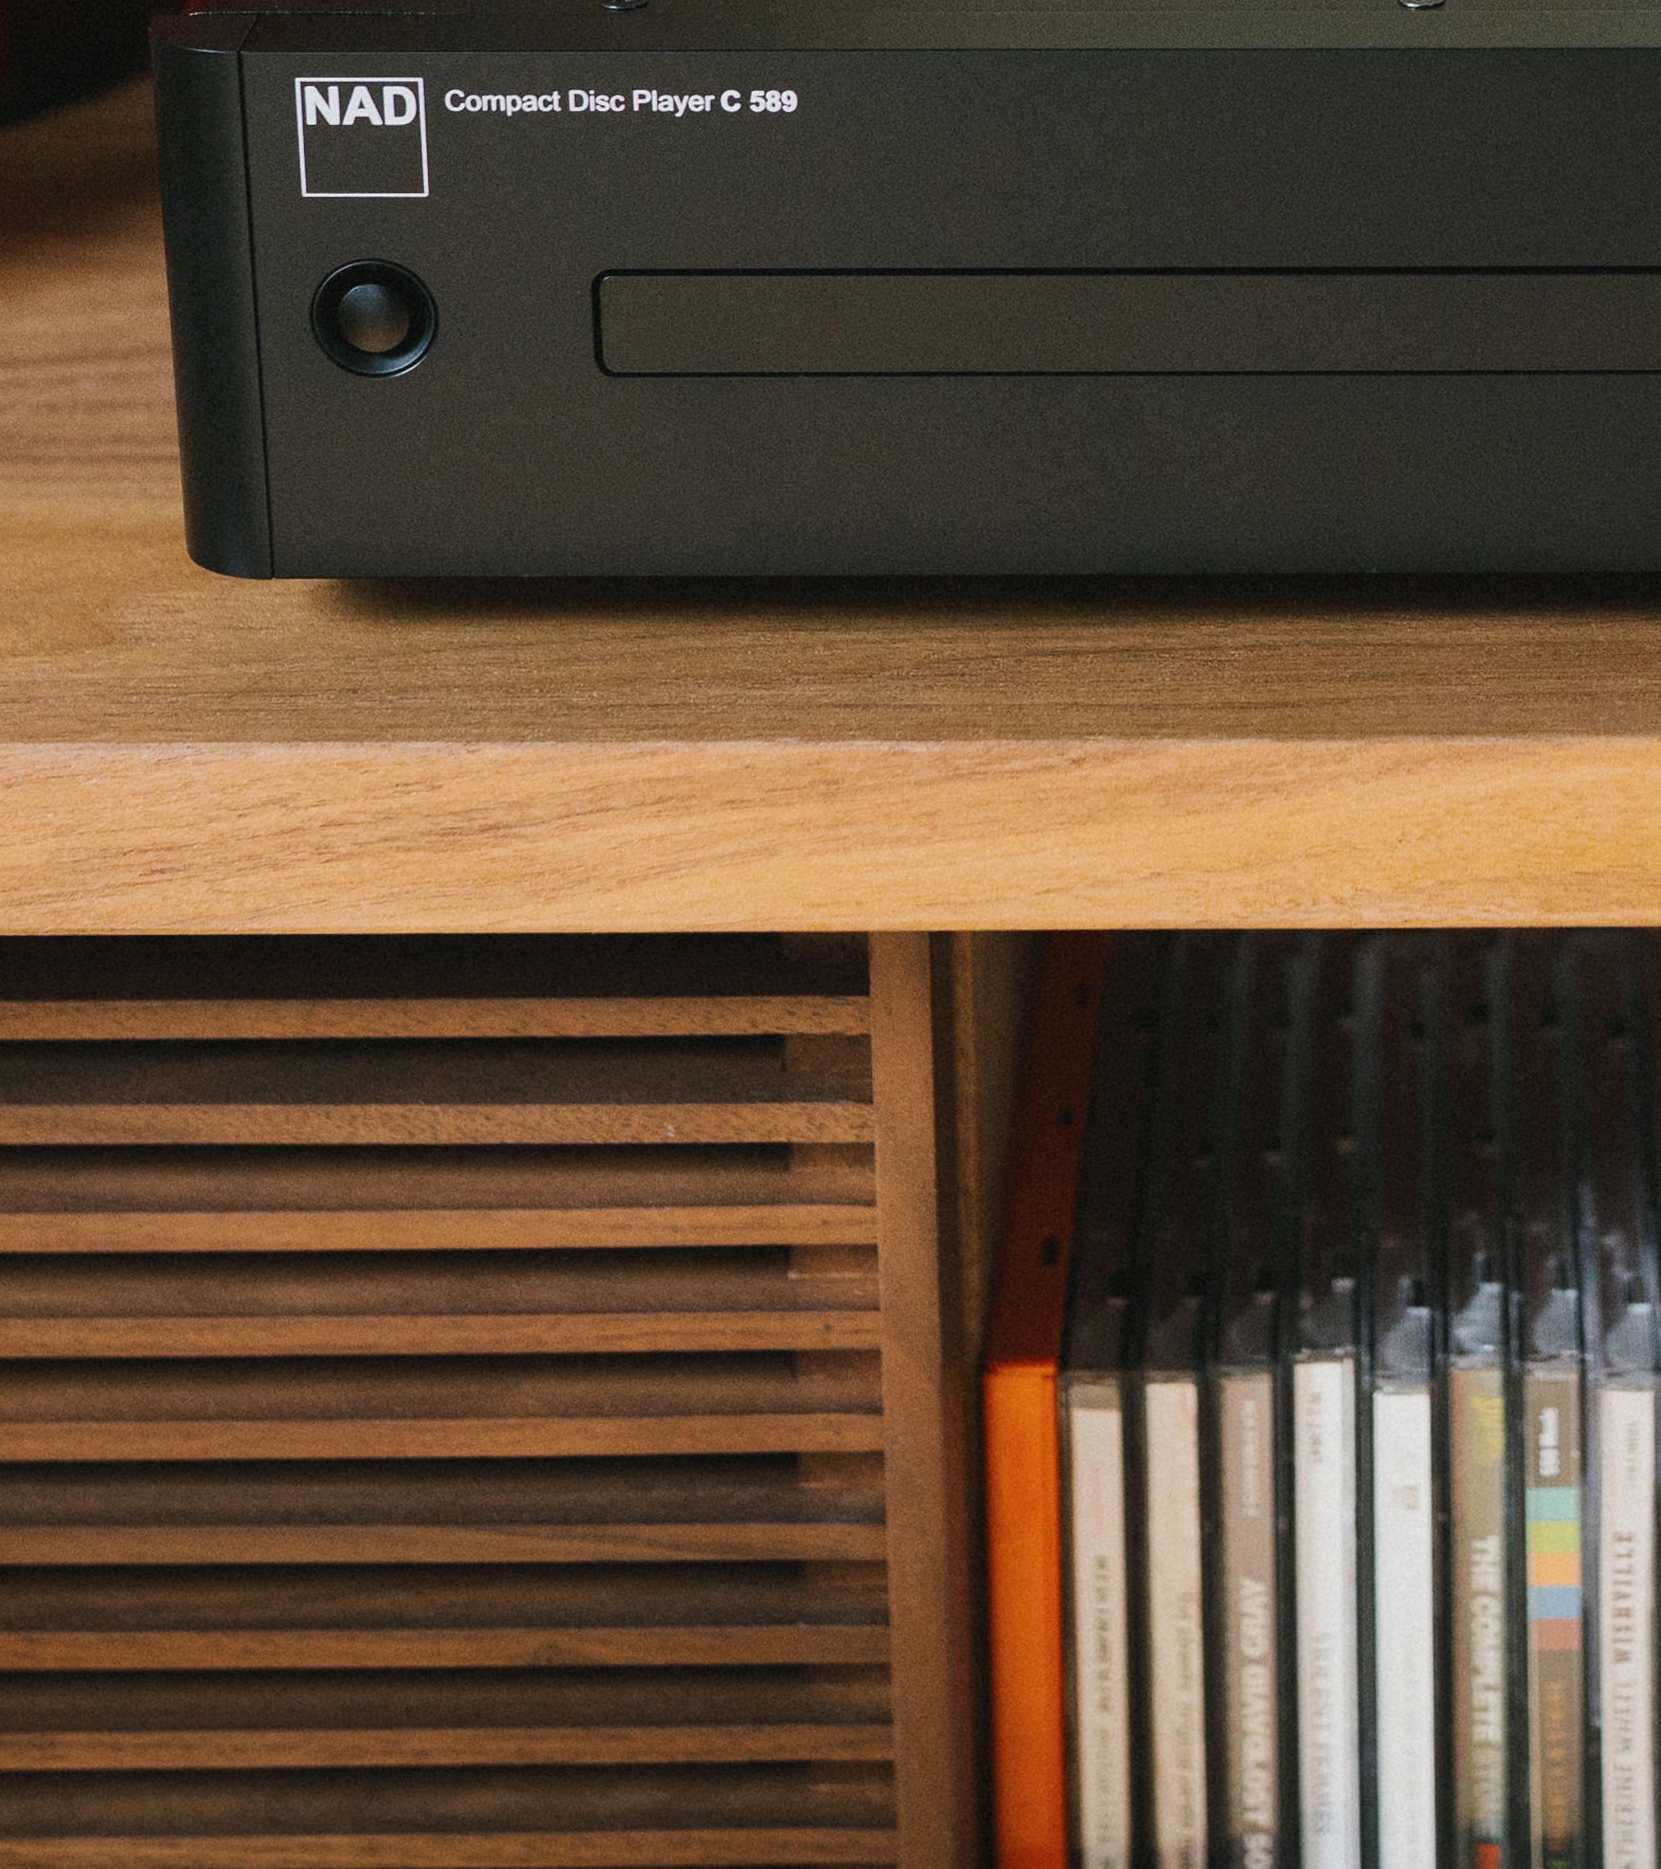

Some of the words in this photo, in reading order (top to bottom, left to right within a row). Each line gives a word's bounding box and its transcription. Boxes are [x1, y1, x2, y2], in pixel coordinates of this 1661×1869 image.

[304, 85, 418, 126] NAD
[444, 88, 561, 117] Compact
[567, 88, 626, 113] Disc
[632, 88, 715, 118] Player
[720, 89, 742, 113] C
[749, 89, 799, 113] 589
[1468, 1534, 1501, 1589] THE
[1238, 1577, 1269, 1658] GRAY
[1612, 1531, 1634, 1665] WISHVILLE
[1469, 1595, 1503, 1743] COMPLETE
